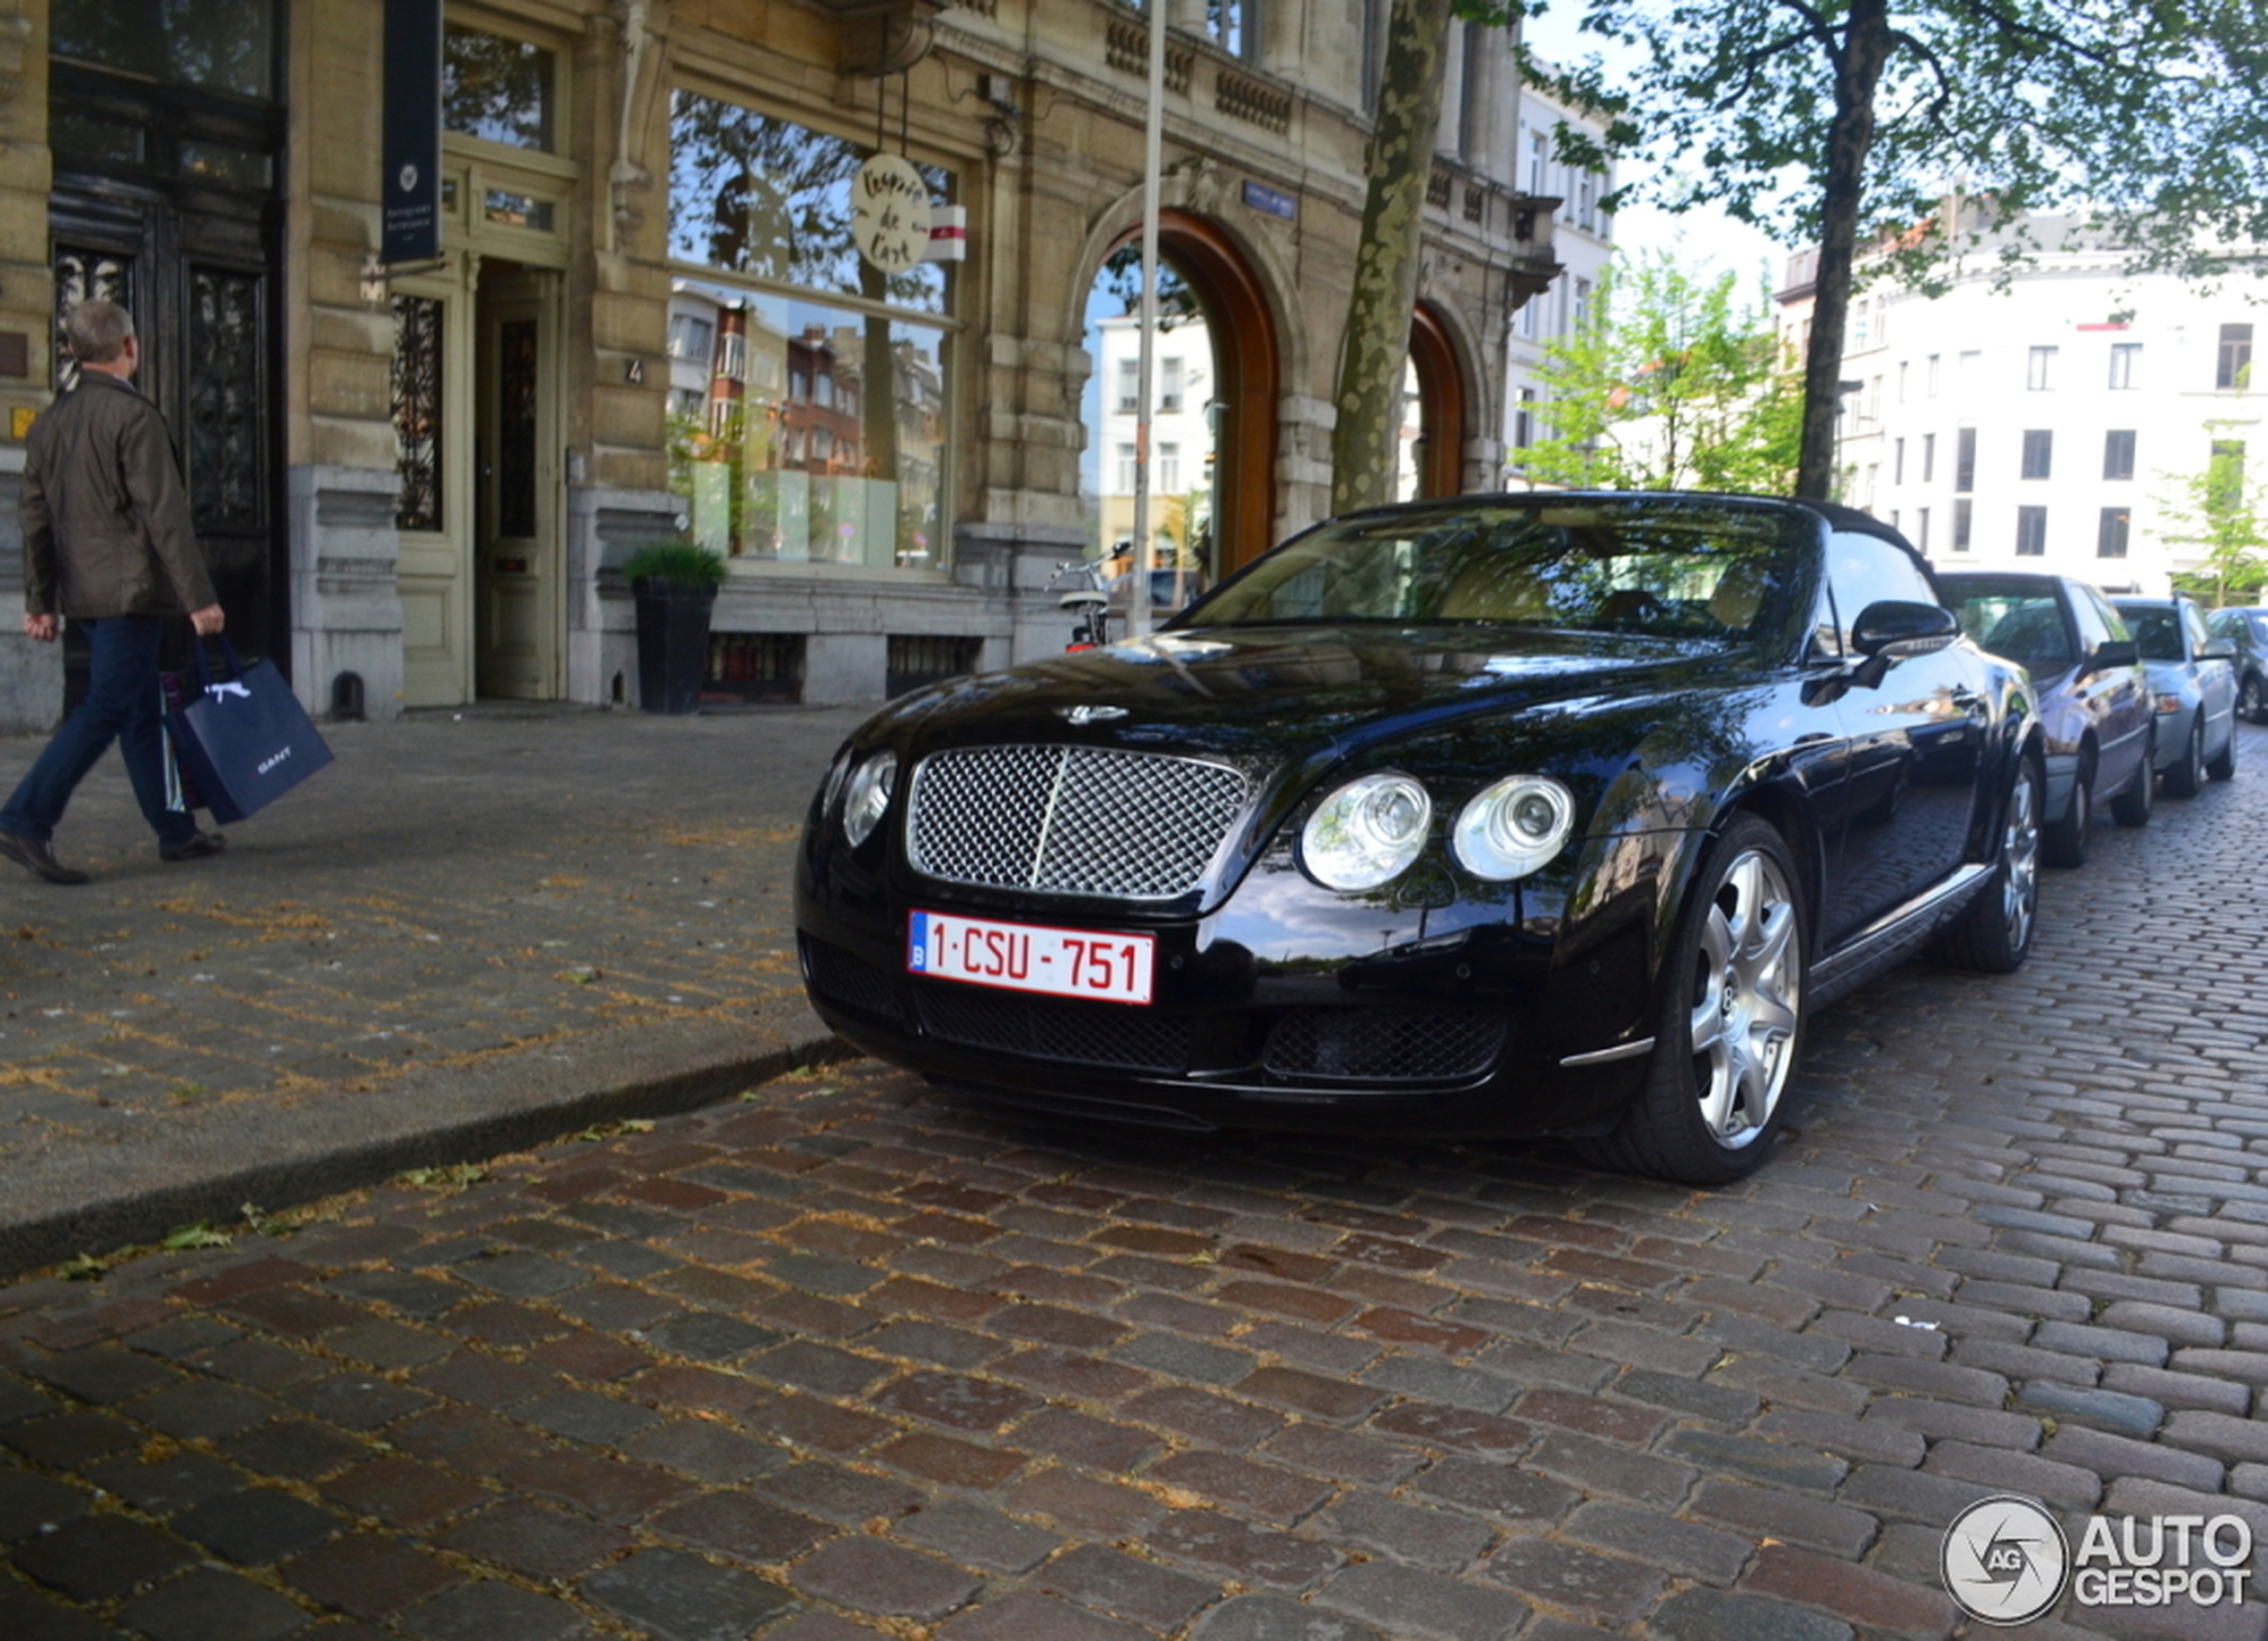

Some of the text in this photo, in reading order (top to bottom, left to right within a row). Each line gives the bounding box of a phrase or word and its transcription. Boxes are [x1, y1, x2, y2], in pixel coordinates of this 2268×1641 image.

[880, 204, 900, 231] de
[870, 232, 911, 264] l'art
[629, 360, 642, 383] 4
[257, 746, 291, 774] GANT
[912, 945, 924, 966] B
